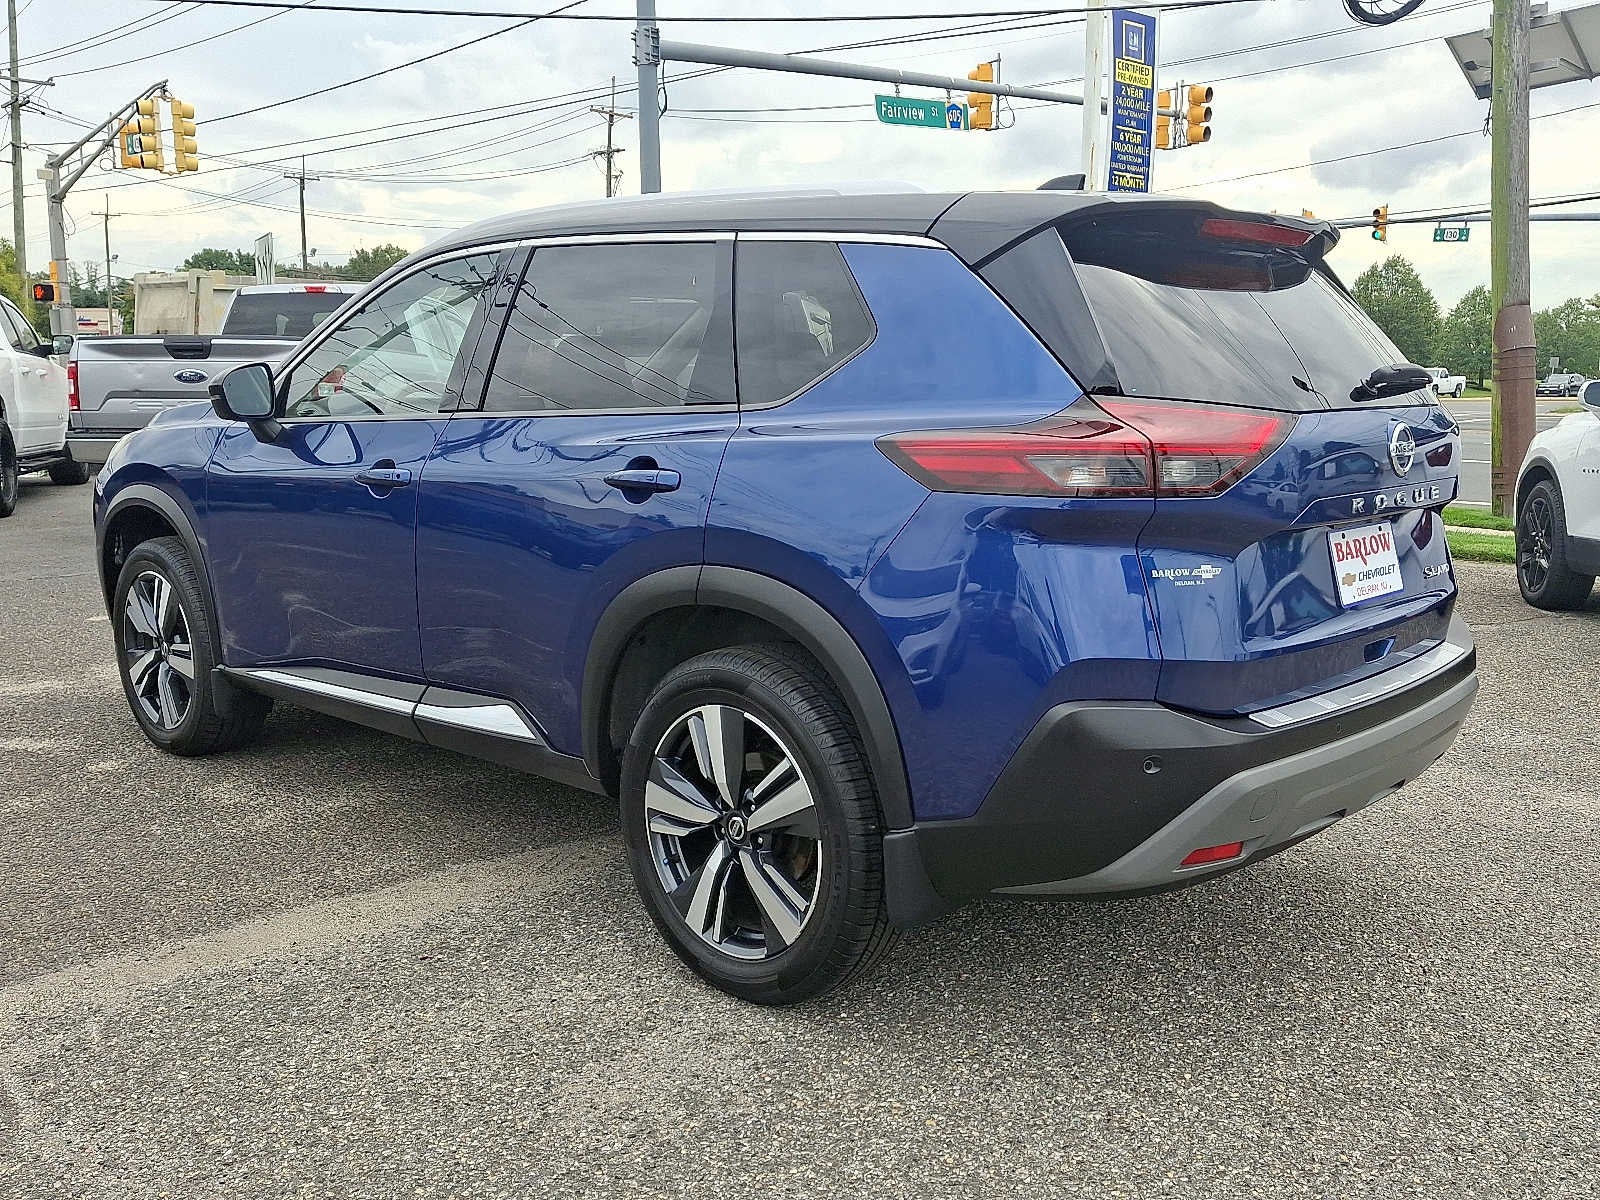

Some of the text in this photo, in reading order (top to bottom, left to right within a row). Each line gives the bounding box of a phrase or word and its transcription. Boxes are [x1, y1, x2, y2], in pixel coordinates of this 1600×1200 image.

[1117, 61, 1150, 77] CERTIFIED
[1117, 71, 1149, 86] PRE-OWNED
[1121, 85, 1144, 100] 2 YEAR
[881, 102, 925, 120] Fairview
[1115, 95, 1151, 112] 24,000 MILE
[948, 109, 961, 122] 605
[1120, 131, 1142, 145] 6 YEAR
[1112, 141, 1150, 157] 100,000 MILE
[1111, 175, 1145, 189] 12 MONTH
[1445, 231, 1458, 239] 130
[1352, 484, 1440, 514] ROGUE
[1334, 532, 1391, 567] BARLOW
[1151, 568, 1190, 581] BARLOW
[1358, 564, 1396, 582] CHEVROLET
